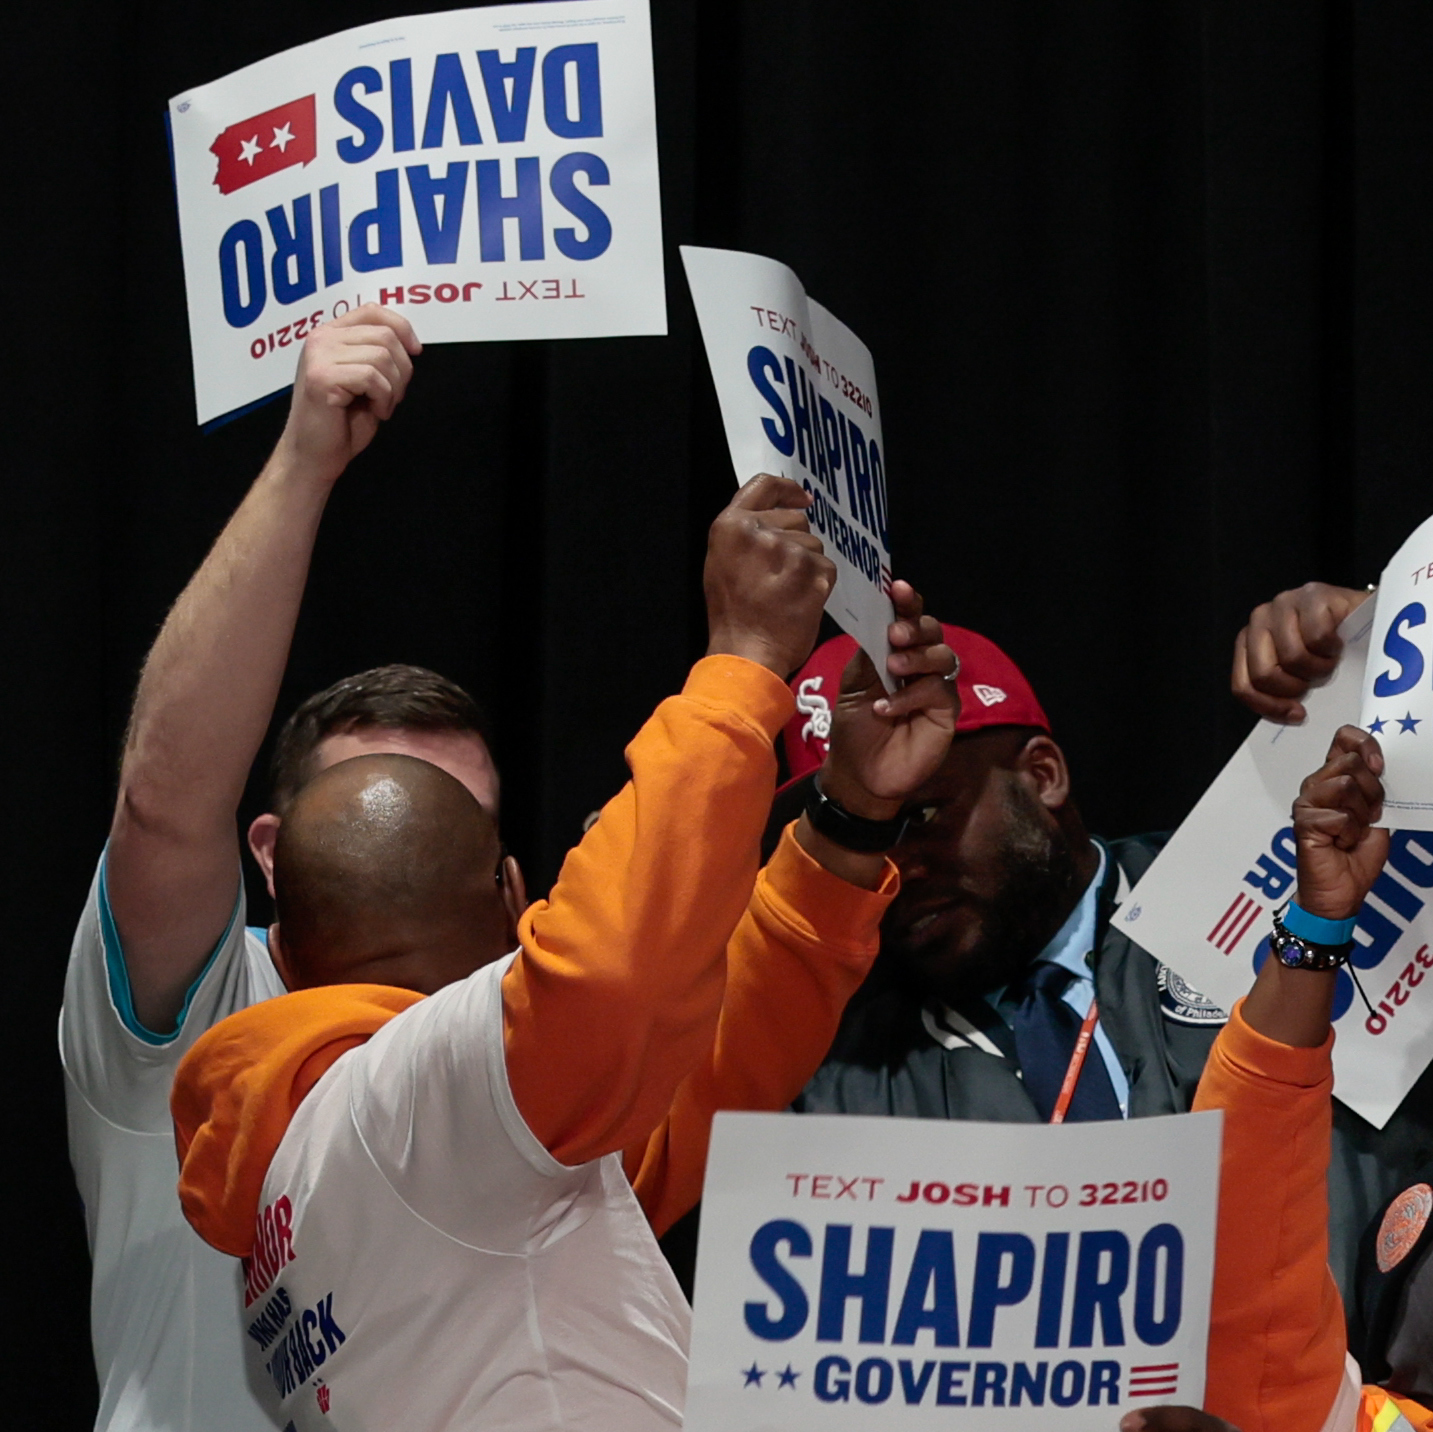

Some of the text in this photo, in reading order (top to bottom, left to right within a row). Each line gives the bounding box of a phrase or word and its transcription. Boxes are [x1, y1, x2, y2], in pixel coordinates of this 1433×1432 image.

[332, 42, 604, 166] DAVIS
[218, 151, 613, 329] SHAPIRO
[379, 282, 483, 305] JOSH
[495, 278, 585, 302] TEXT
[250, 310, 324, 359] 32210
[750, 306, 798, 341] TEXT
[822, 360, 840, 389] TO
[841, 374, 873, 420] 32210
[747, 345, 890, 554] SHAPIRO
[803, 478, 883, 594] GOVERNOR
[786, 1174, 1168, 1208] TEXT JOSH TO 32210
[743, 1218, 1185, 1348] SHAPIRO
[813, 1354, 1121, 1407] GOVERNOR
